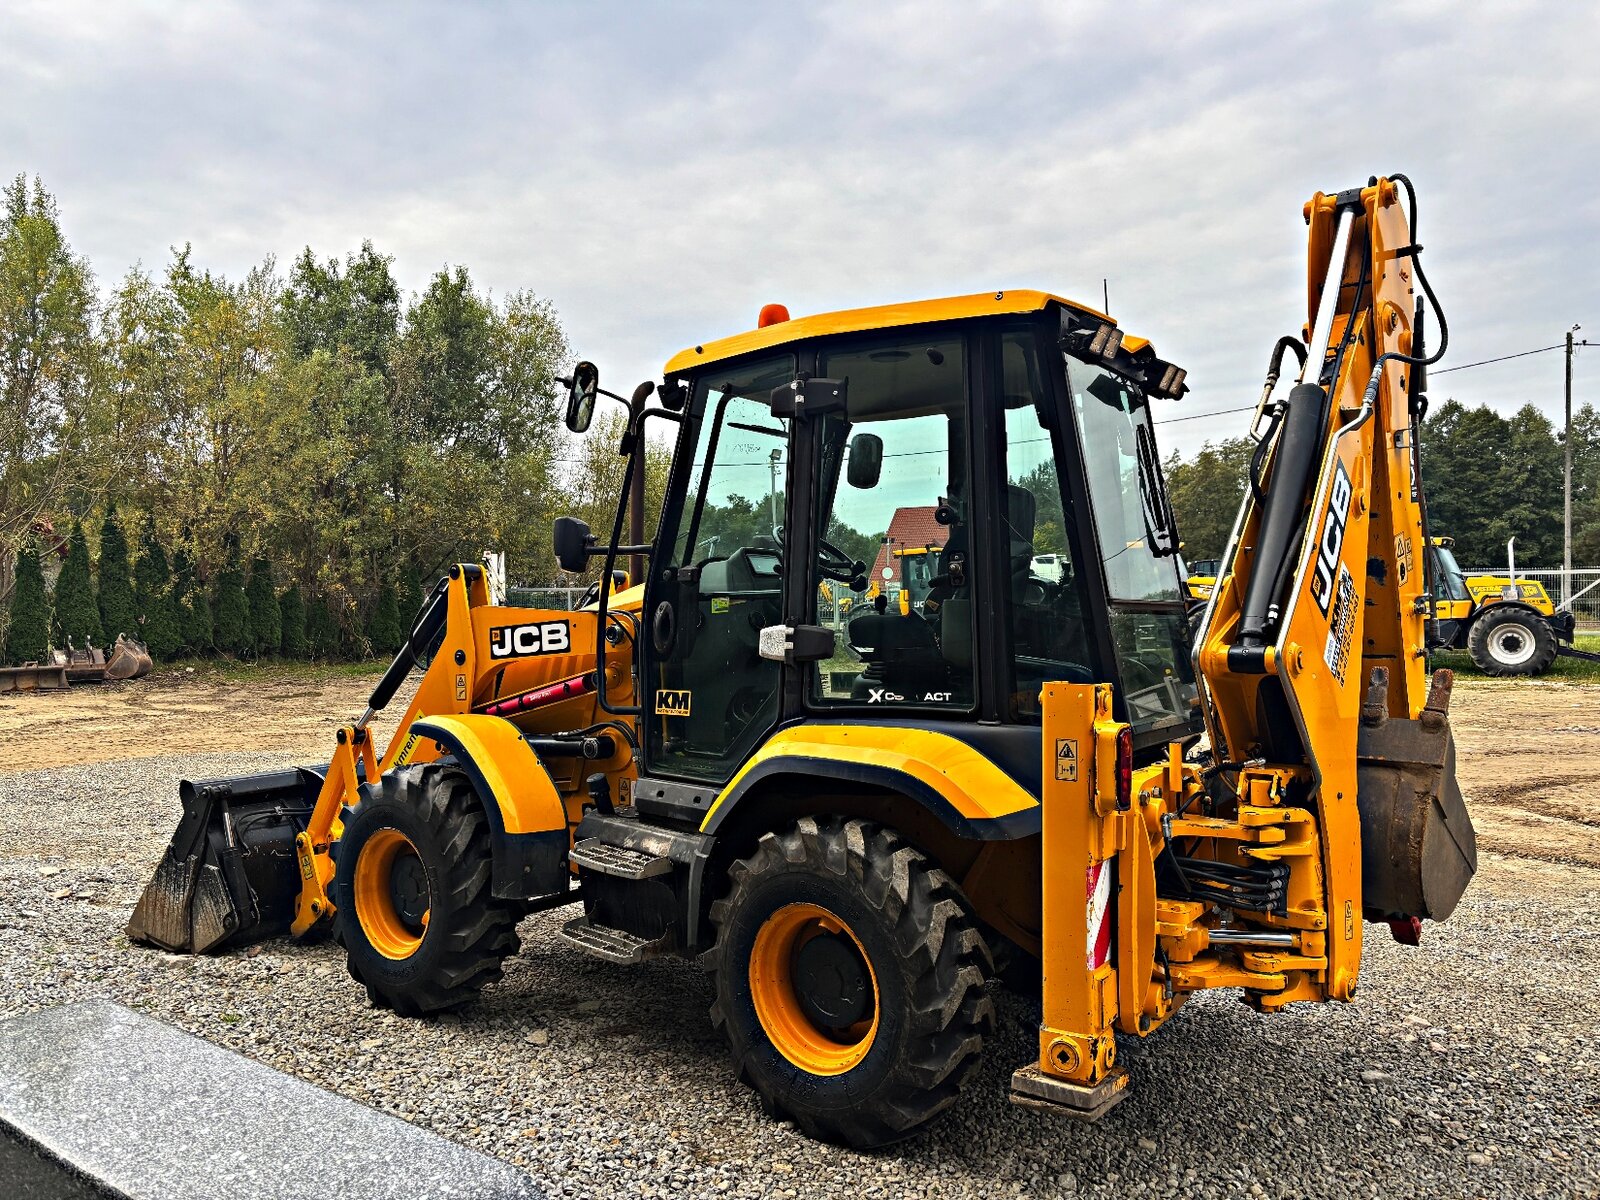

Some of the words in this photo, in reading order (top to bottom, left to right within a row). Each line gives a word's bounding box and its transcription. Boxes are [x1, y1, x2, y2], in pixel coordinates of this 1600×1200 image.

[1317, 468, 1351, 609] JCB
[492, 623, 569, 656] JCB
[657, 691, 689, 710] KM
[393, 733, 417, 767] kmren
